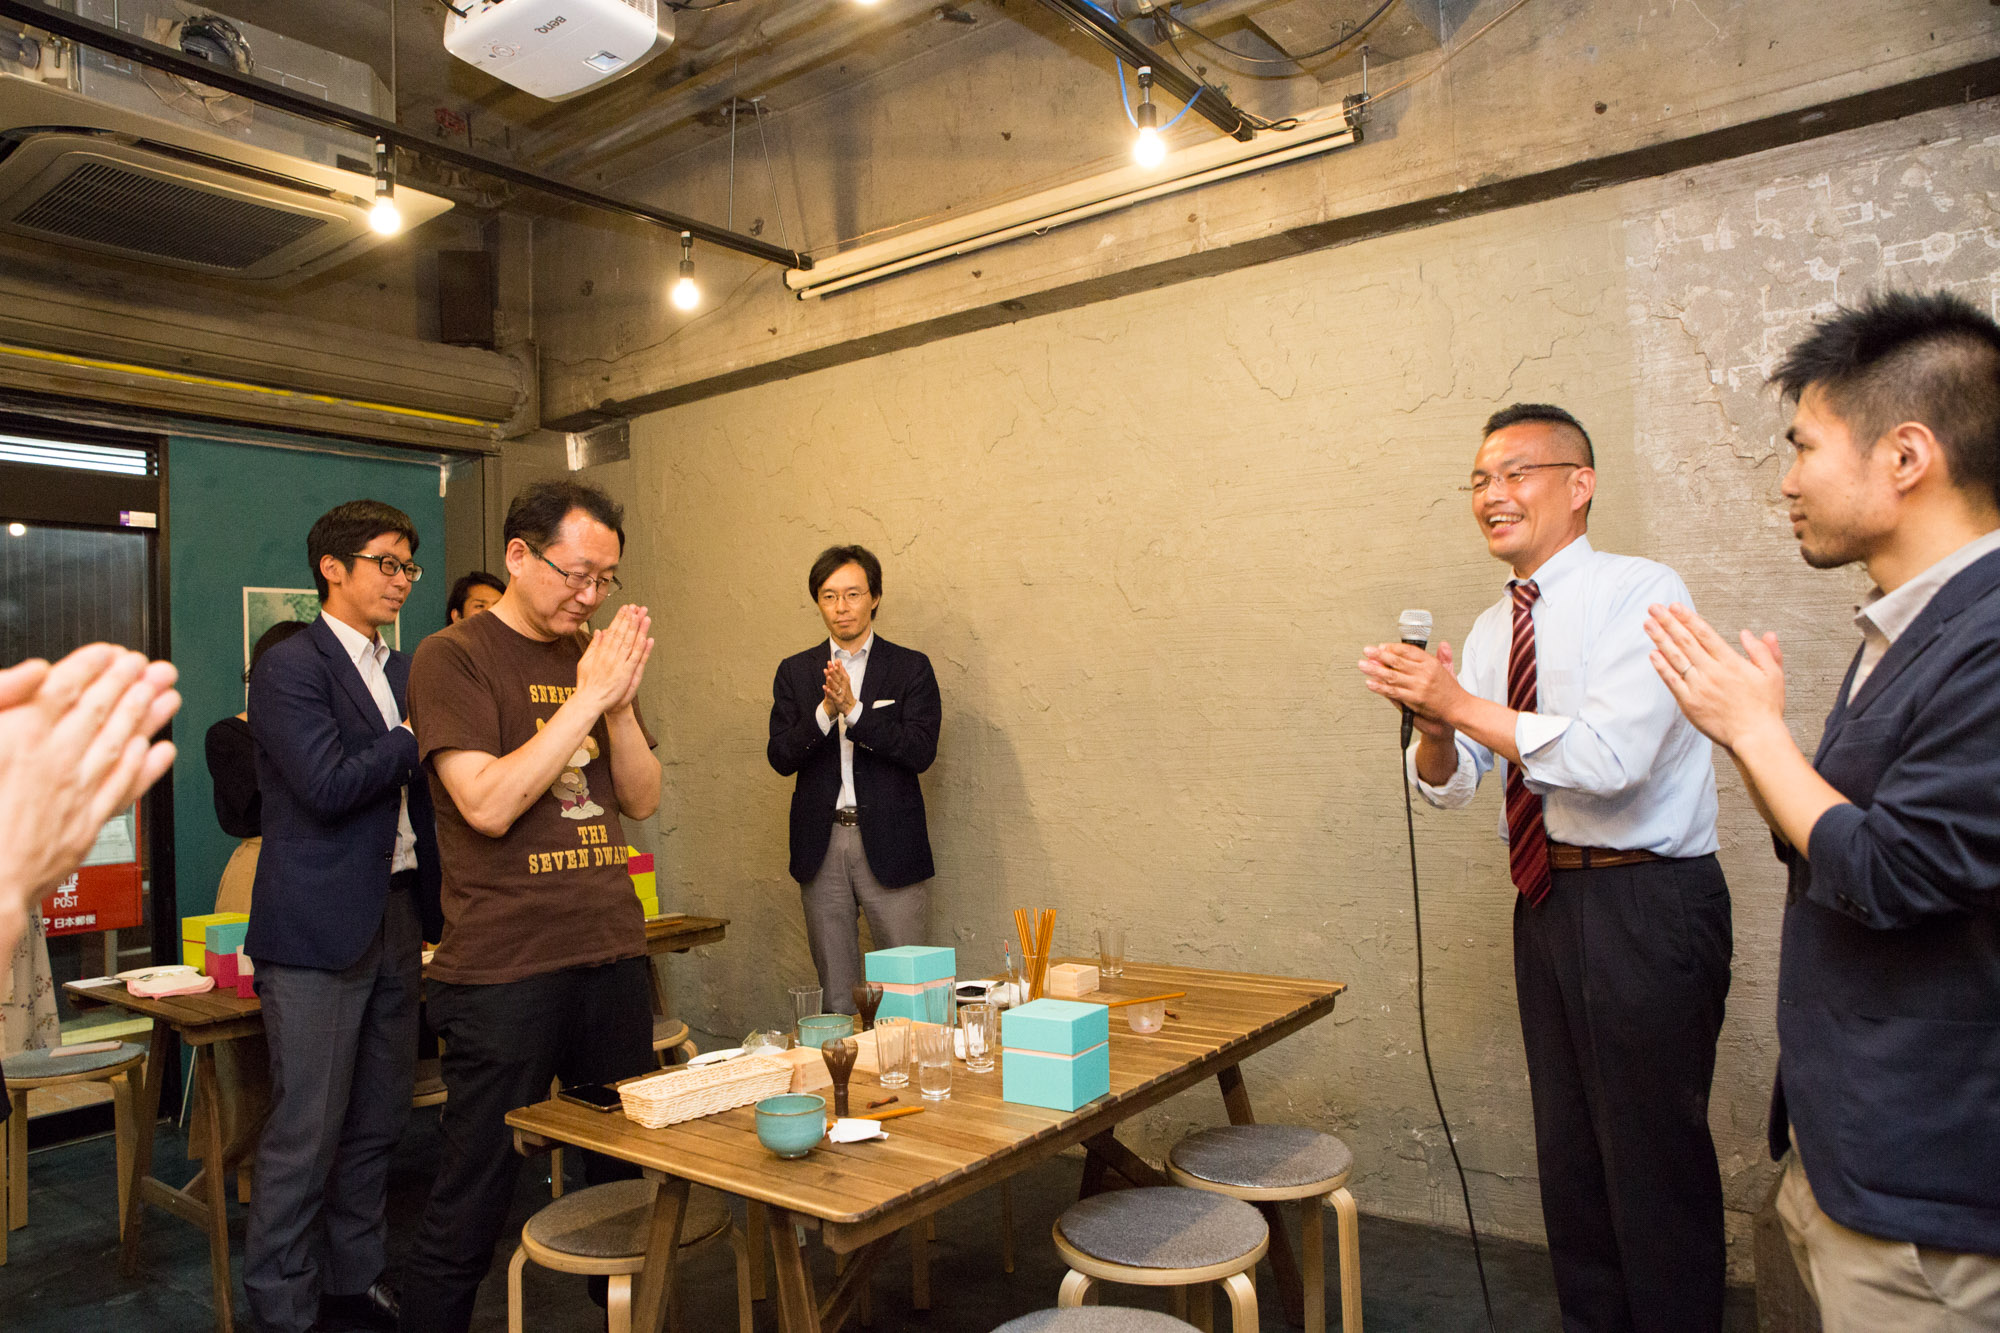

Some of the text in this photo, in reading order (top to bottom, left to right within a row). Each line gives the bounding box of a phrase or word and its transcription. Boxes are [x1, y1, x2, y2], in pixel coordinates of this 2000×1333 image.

[534, 15, 567, 34] BenQ
[529, 684, 577, 704] SNEEZ
[577, 824, 608, 845] THE
[528, 848, 589, 874] SEVEN
[53, 895, 79, 909] POST
[54, 914, 96, 929] 日本郵便
